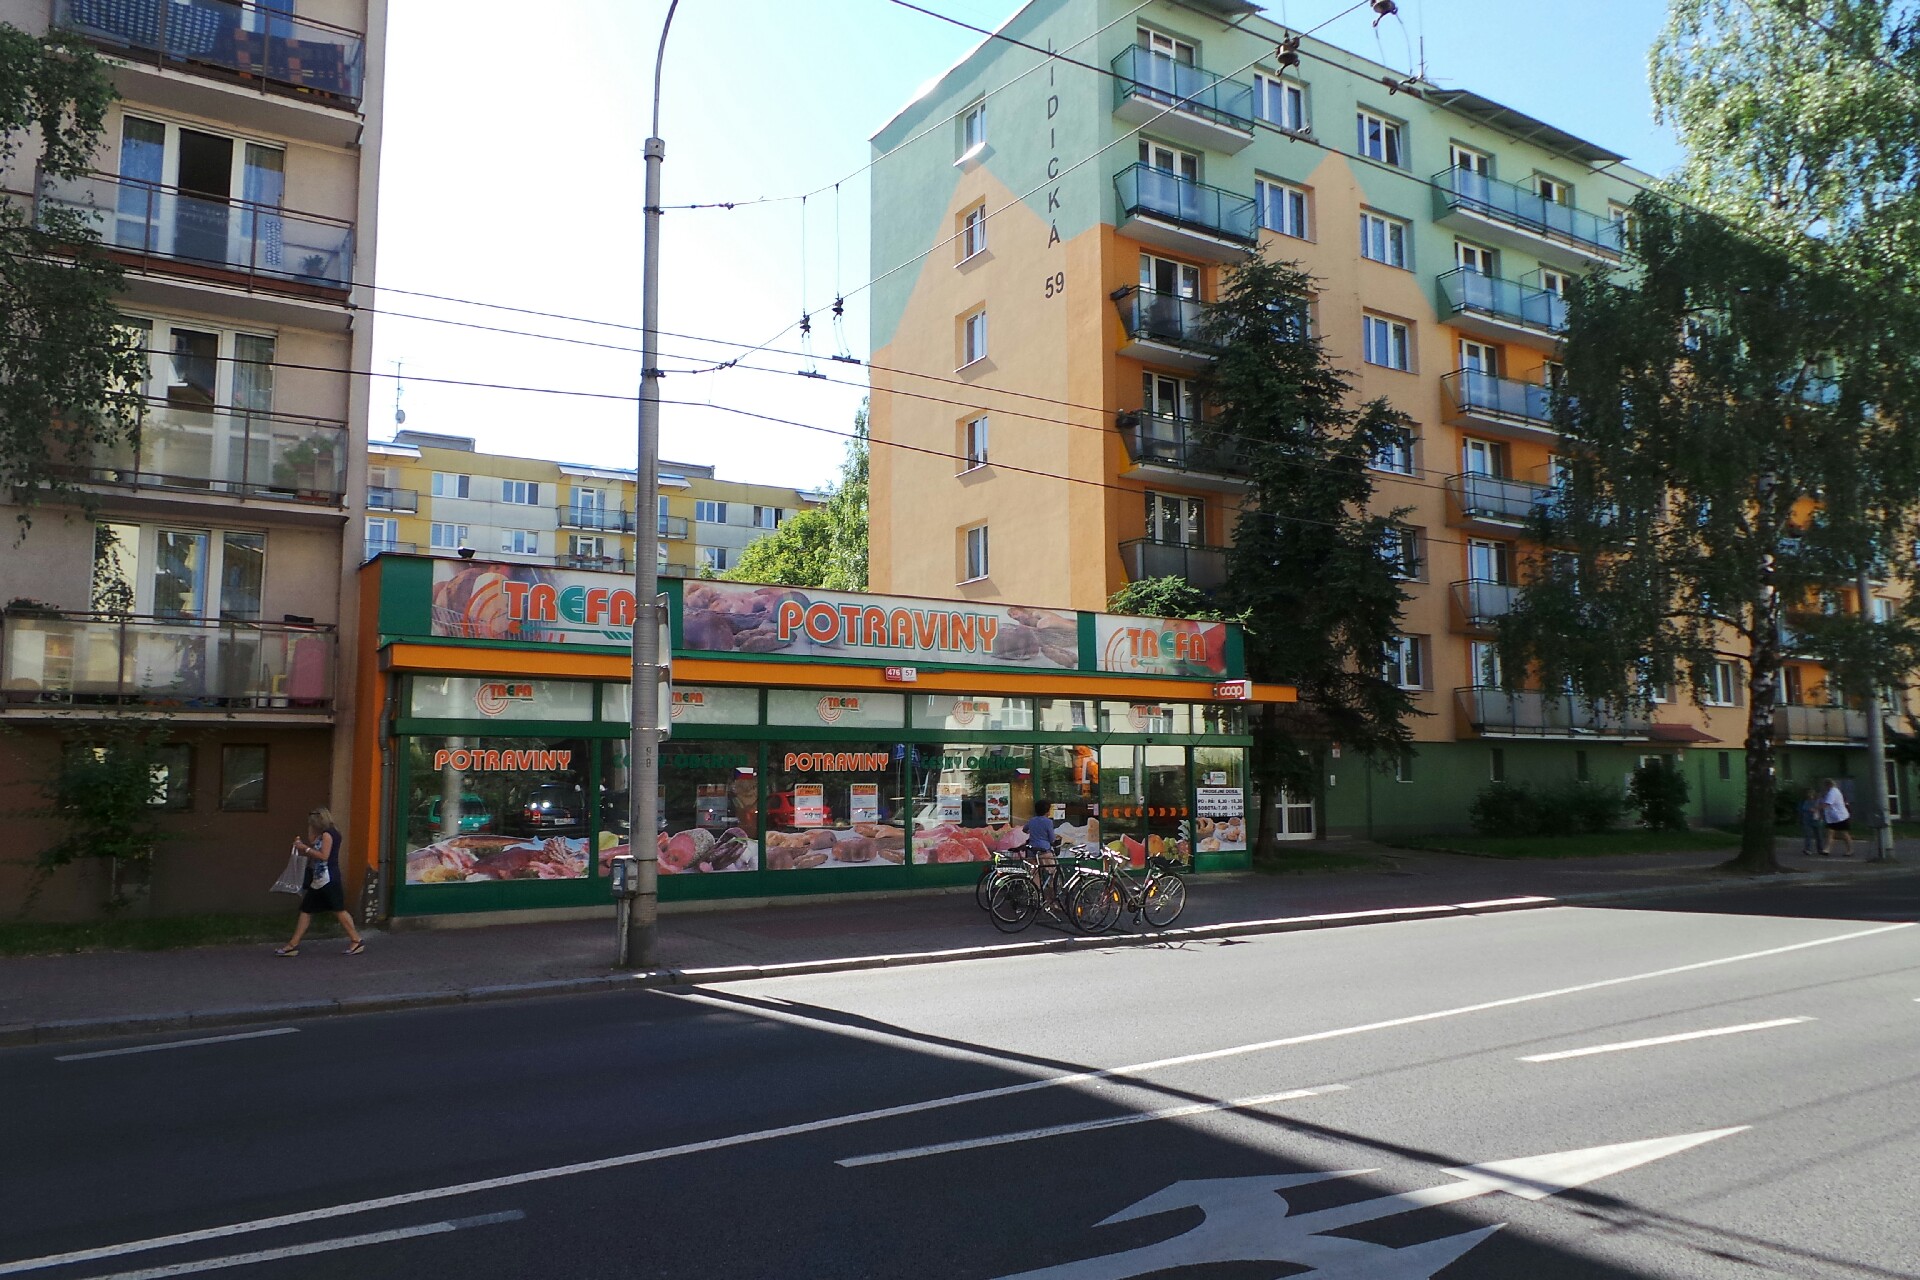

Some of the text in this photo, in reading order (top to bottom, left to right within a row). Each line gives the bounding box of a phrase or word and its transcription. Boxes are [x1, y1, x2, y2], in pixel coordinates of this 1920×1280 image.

[1047, 37, 1061, 250] LIDICKÁ
[1045, 270, 1065, 299] 59
[502, 579, 637, 627] TREFA
[777, 600, 999, 654] POTRAVINY
[1126, 627, 1206, 661] TREFA
[887, 668, 901, 676] 476
[489, 683, 534, 697] TREFA
[1219, 685, 1243, 698] coop
[827, 697, 859, 708] TREFA
[434, 749, 572, 770] POTRAVINY
[784, 752, 889, 772] POTRAVINY
